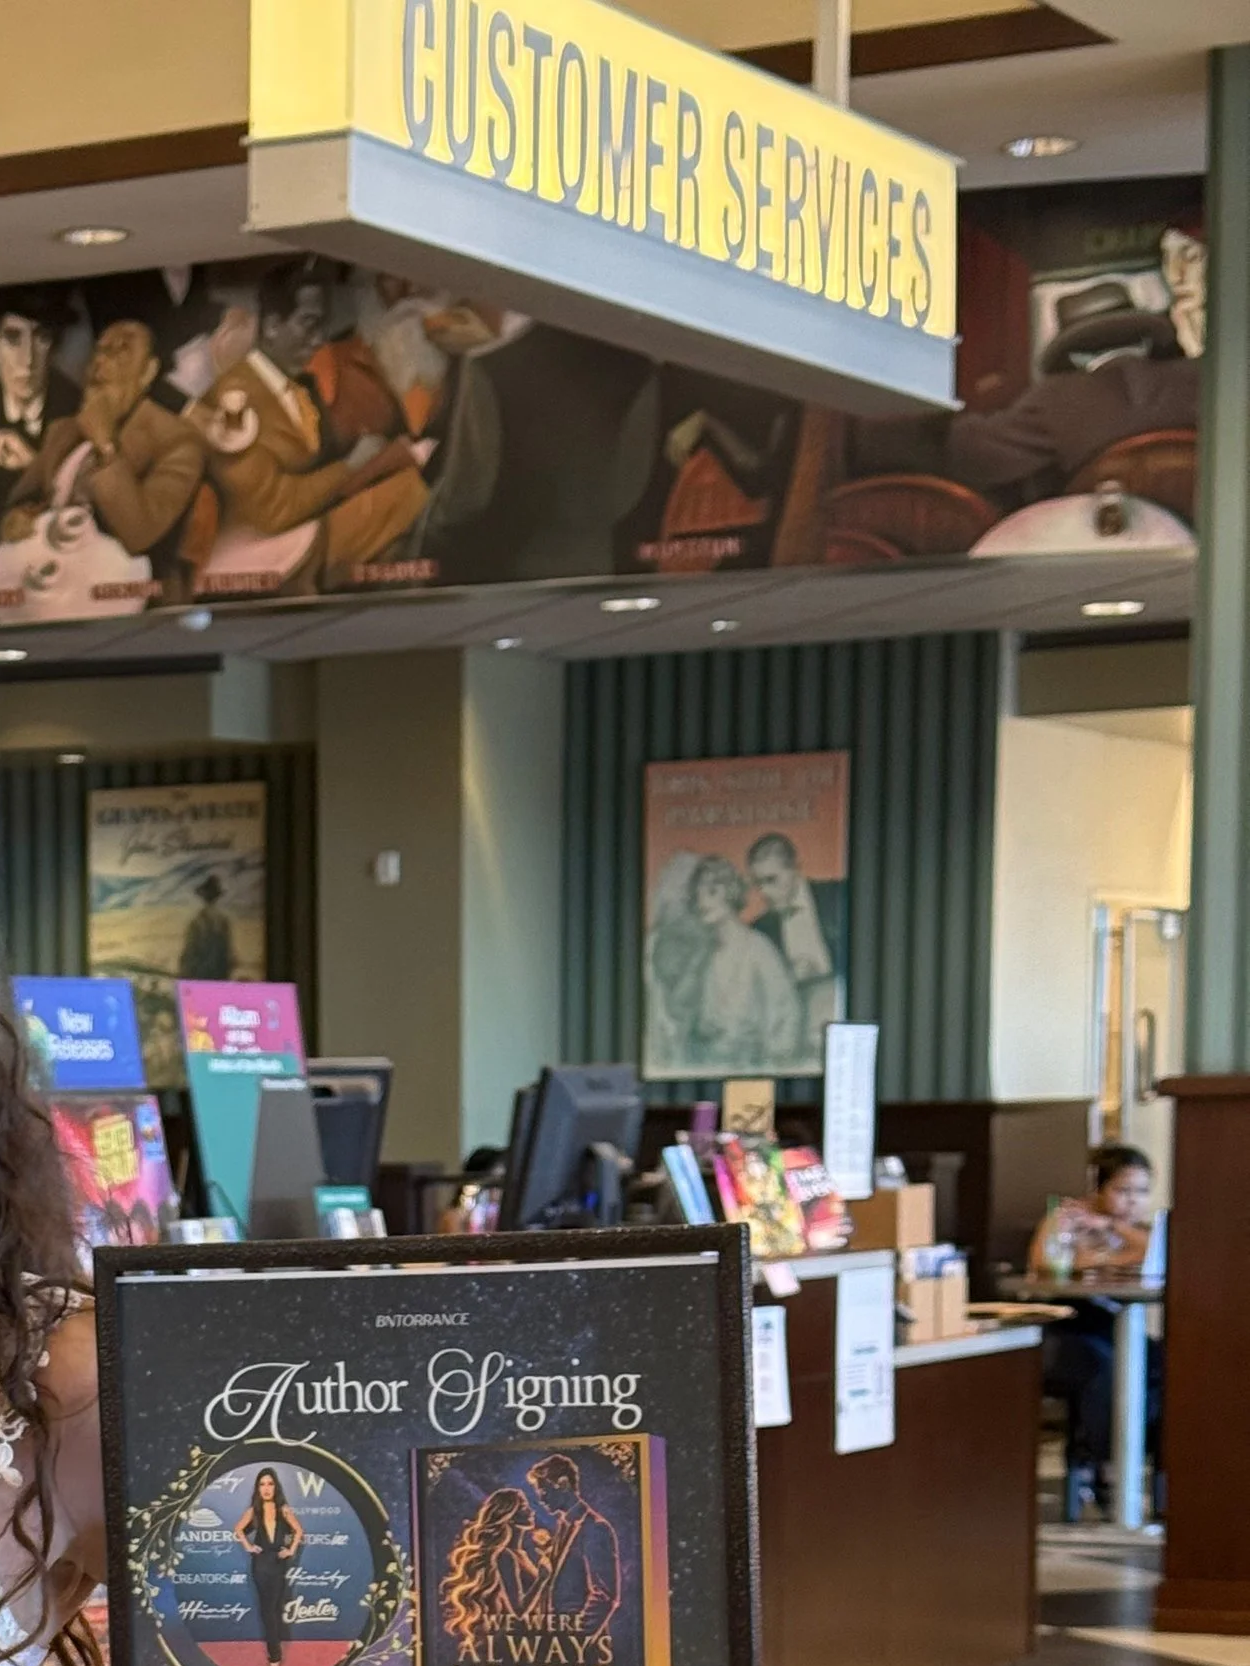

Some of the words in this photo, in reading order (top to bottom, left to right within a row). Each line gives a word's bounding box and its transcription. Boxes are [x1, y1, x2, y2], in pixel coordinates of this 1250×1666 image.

[403, 0, 703, 250] CUSTOMER
[722, 110, 932, 331] SERVICES
[375, 1311, 470, 1328] BNTORRANCE
[203, 1360, 409, 1446] Author
[427, 1347, 644, 1437] Signing
[296, 1472, 326, 1498] W
[483, 1612, 516, 1632] WE
[520, 1613, 586, 1633] WERE
[457, 1634, 614, 1665] ALWAYS
